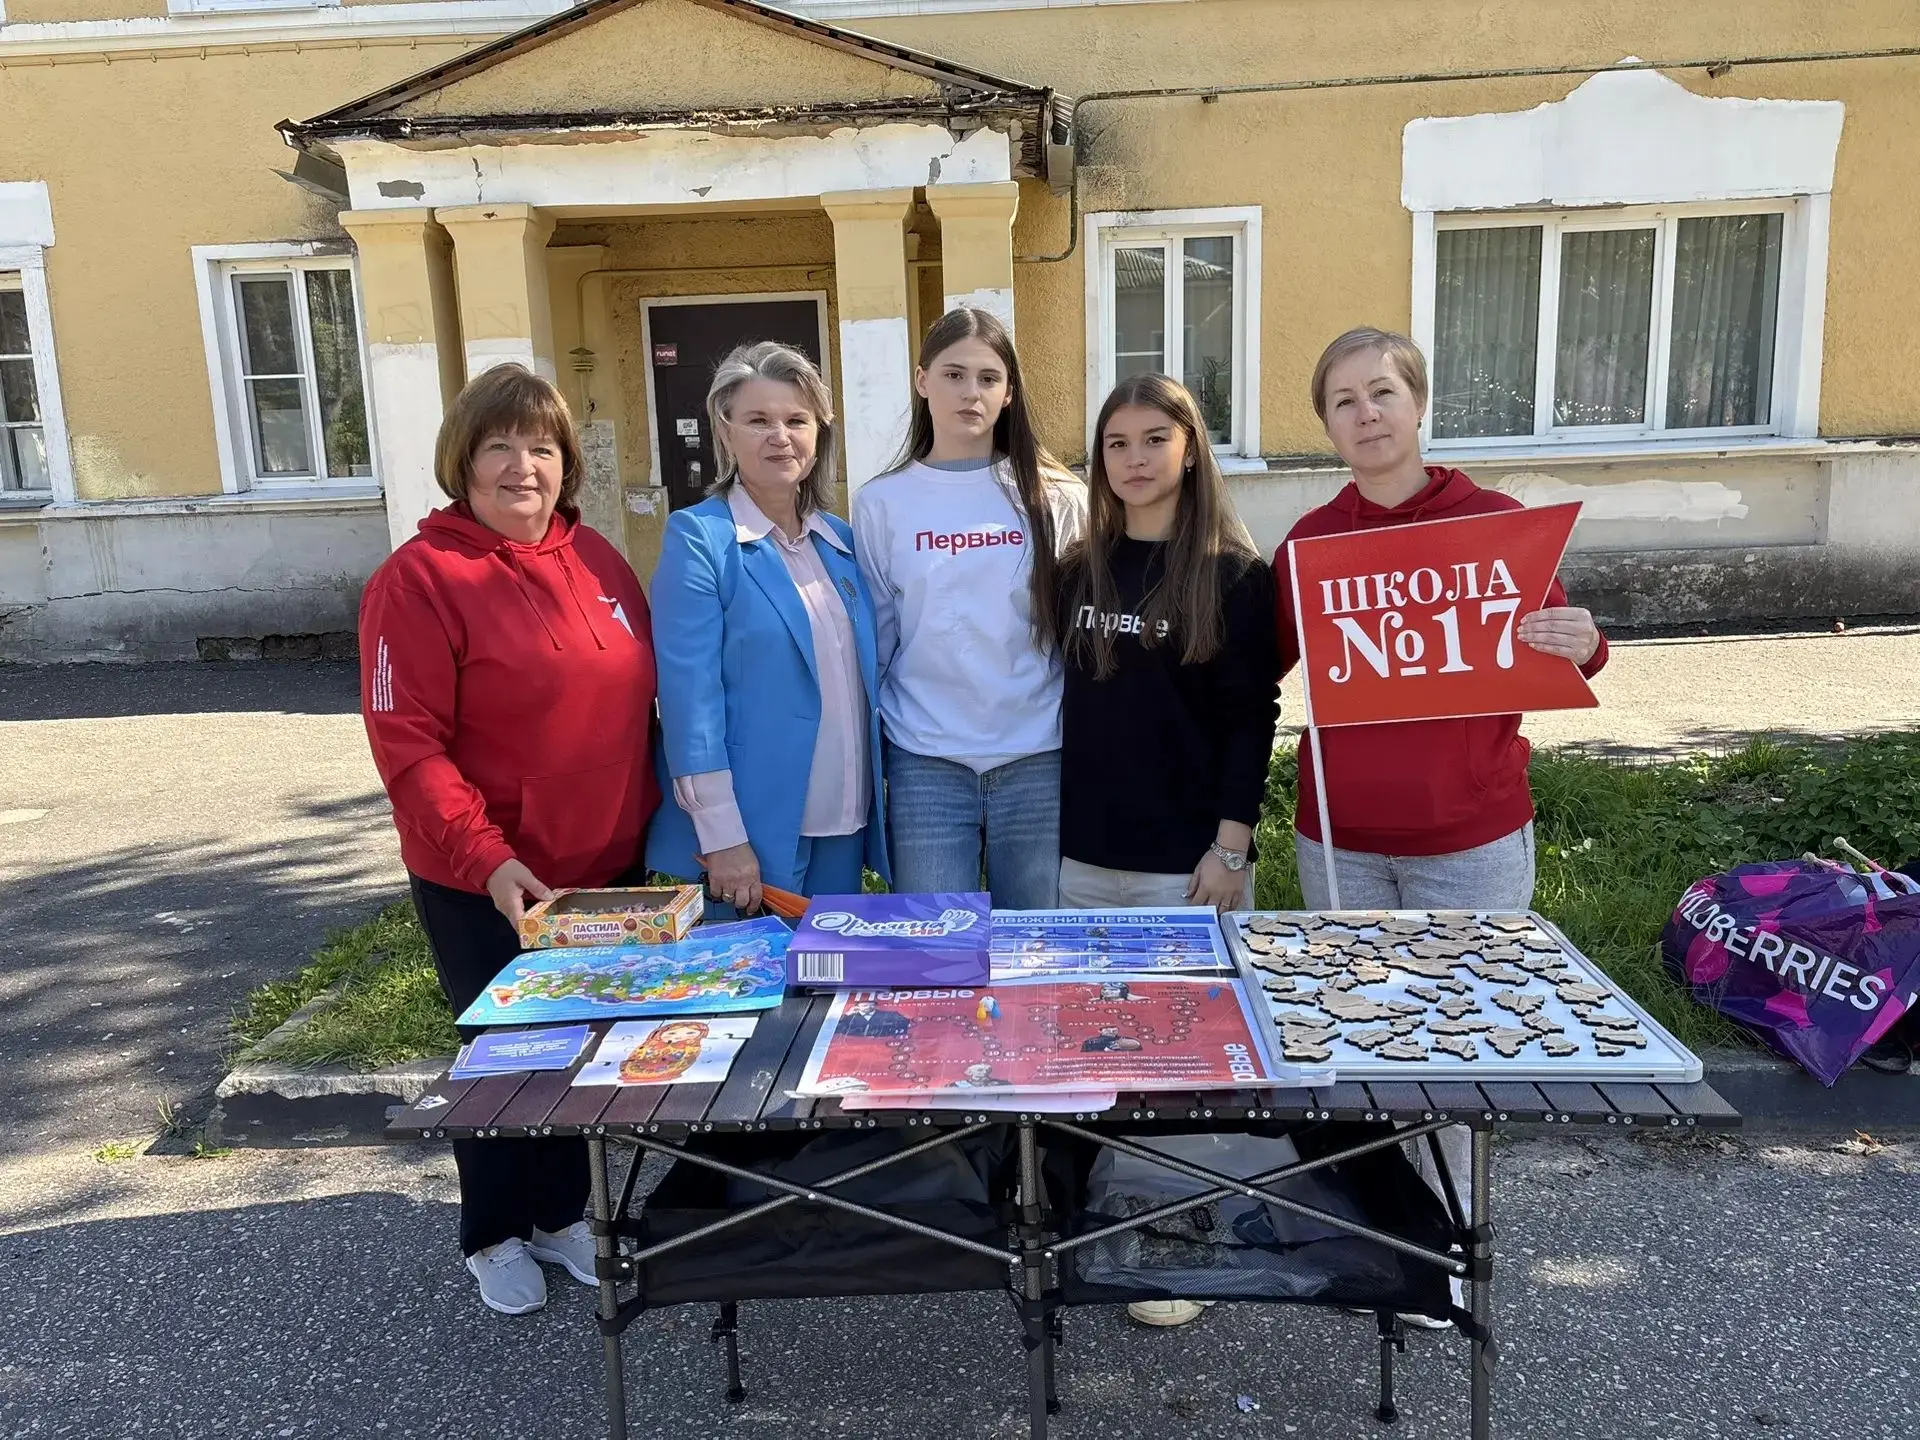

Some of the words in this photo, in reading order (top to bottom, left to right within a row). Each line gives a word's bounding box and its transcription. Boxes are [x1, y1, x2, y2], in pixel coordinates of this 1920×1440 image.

[914, 529, 1024, 556] Первые
[1318, 558, 1521, 615] ШКОЛА
[1328, 597, 1522, 683] №17
[572, 921, 620, 934] ПАСТИЛА
[992, 916, 1088, 924] ДВИЖЕНИЕ
[1094, 916, 1167, 924] ПЕРВЫХ
[573, 931, 620, 941] фруктовая
[853, 988, 975, 1004] Первые
[1223, 1043, 1267, 1082] рвые
